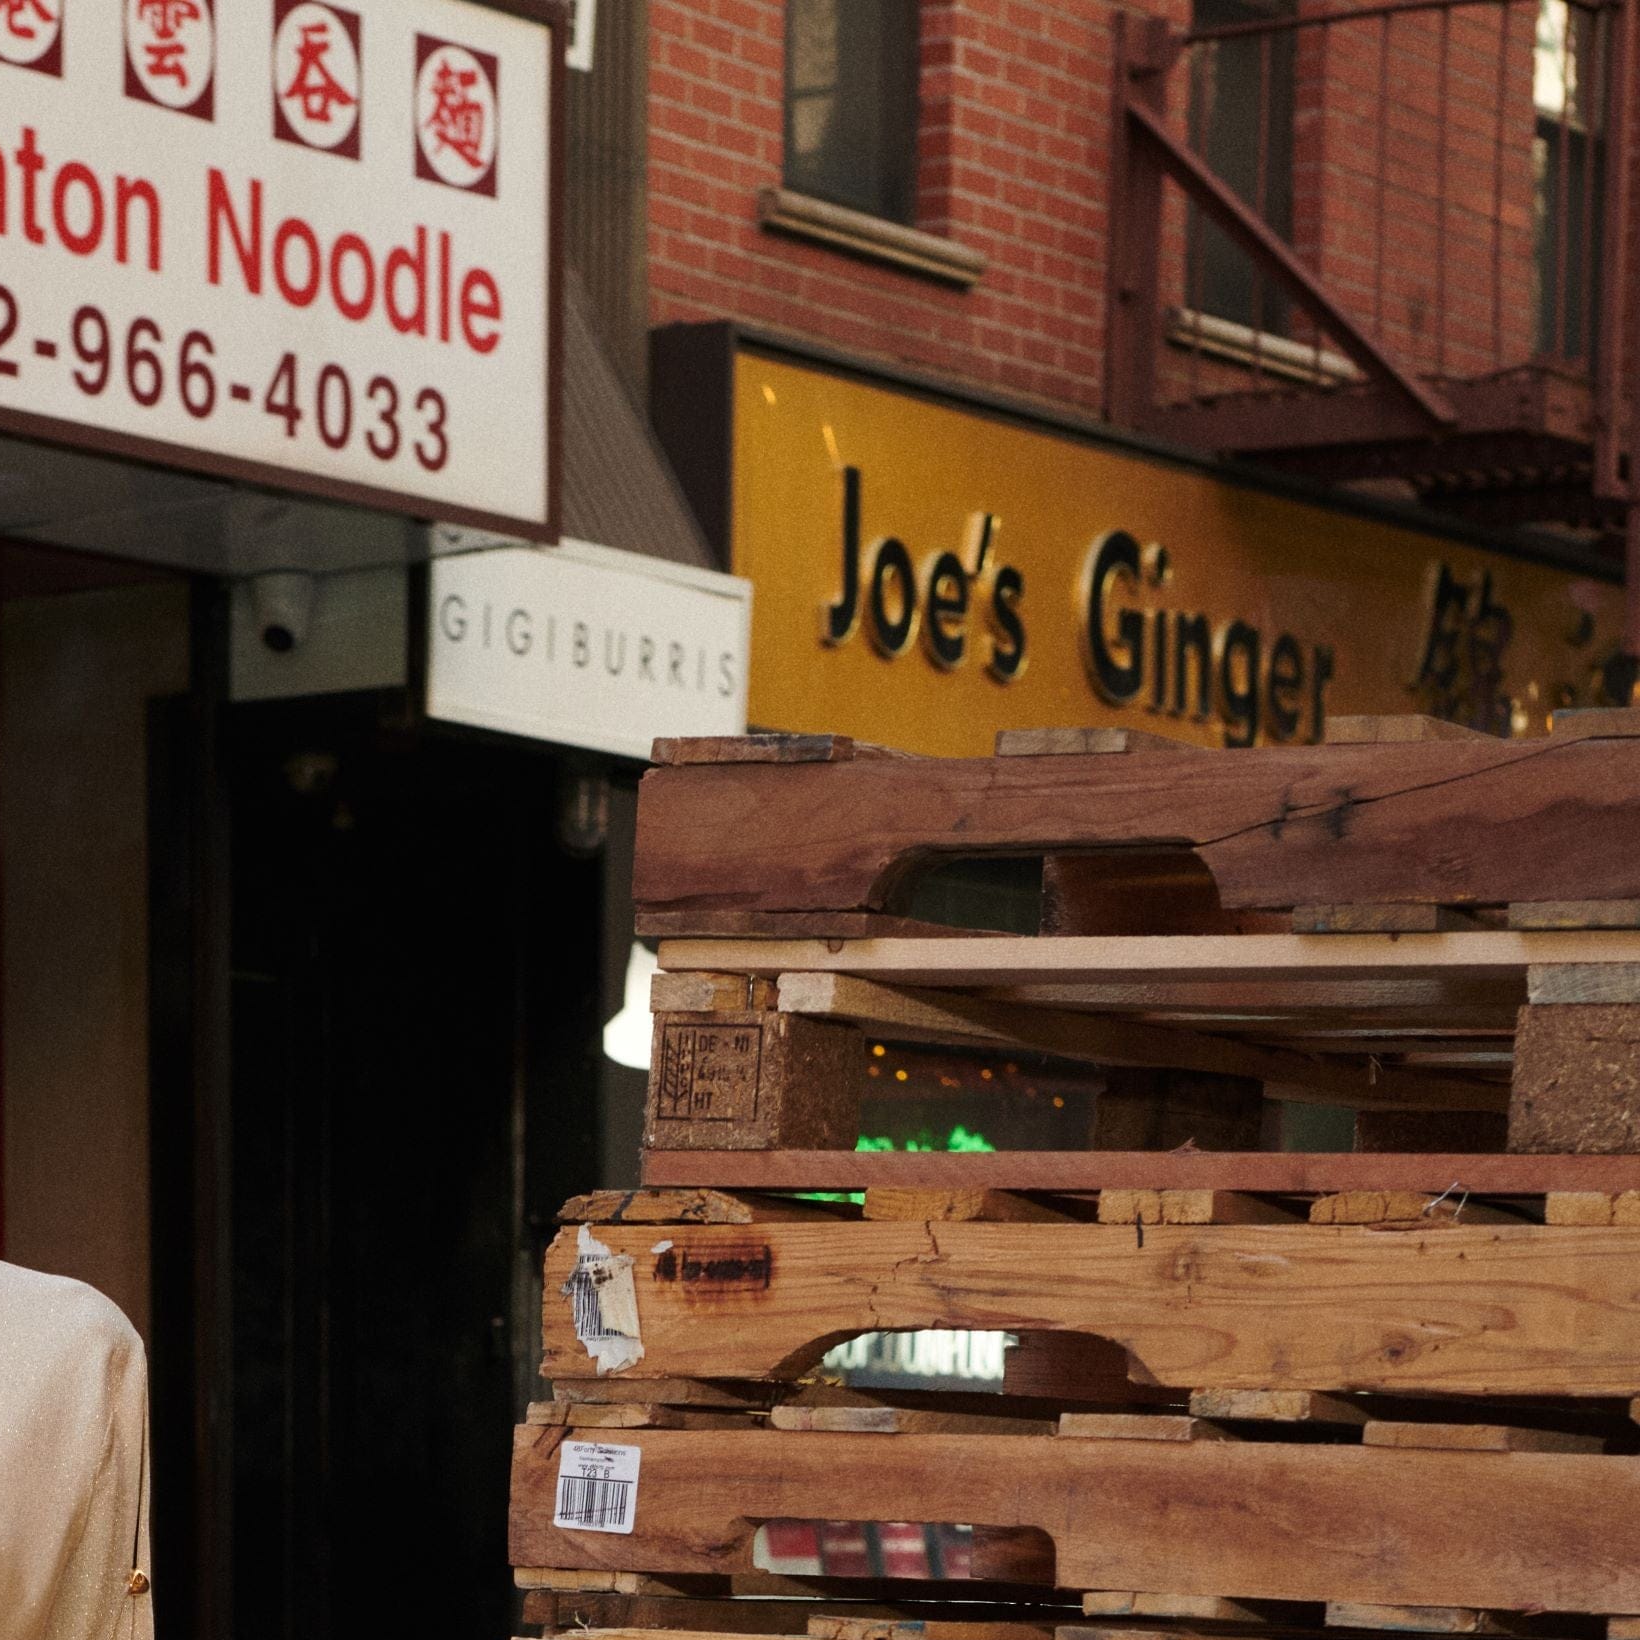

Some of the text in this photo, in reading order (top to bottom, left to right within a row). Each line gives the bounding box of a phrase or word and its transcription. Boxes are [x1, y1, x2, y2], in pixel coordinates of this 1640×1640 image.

[208, 167, 502, 355] Noodle
[820, 464, 1028, 686] Joe's
[1080, 527, 1337, 749] Ginger
